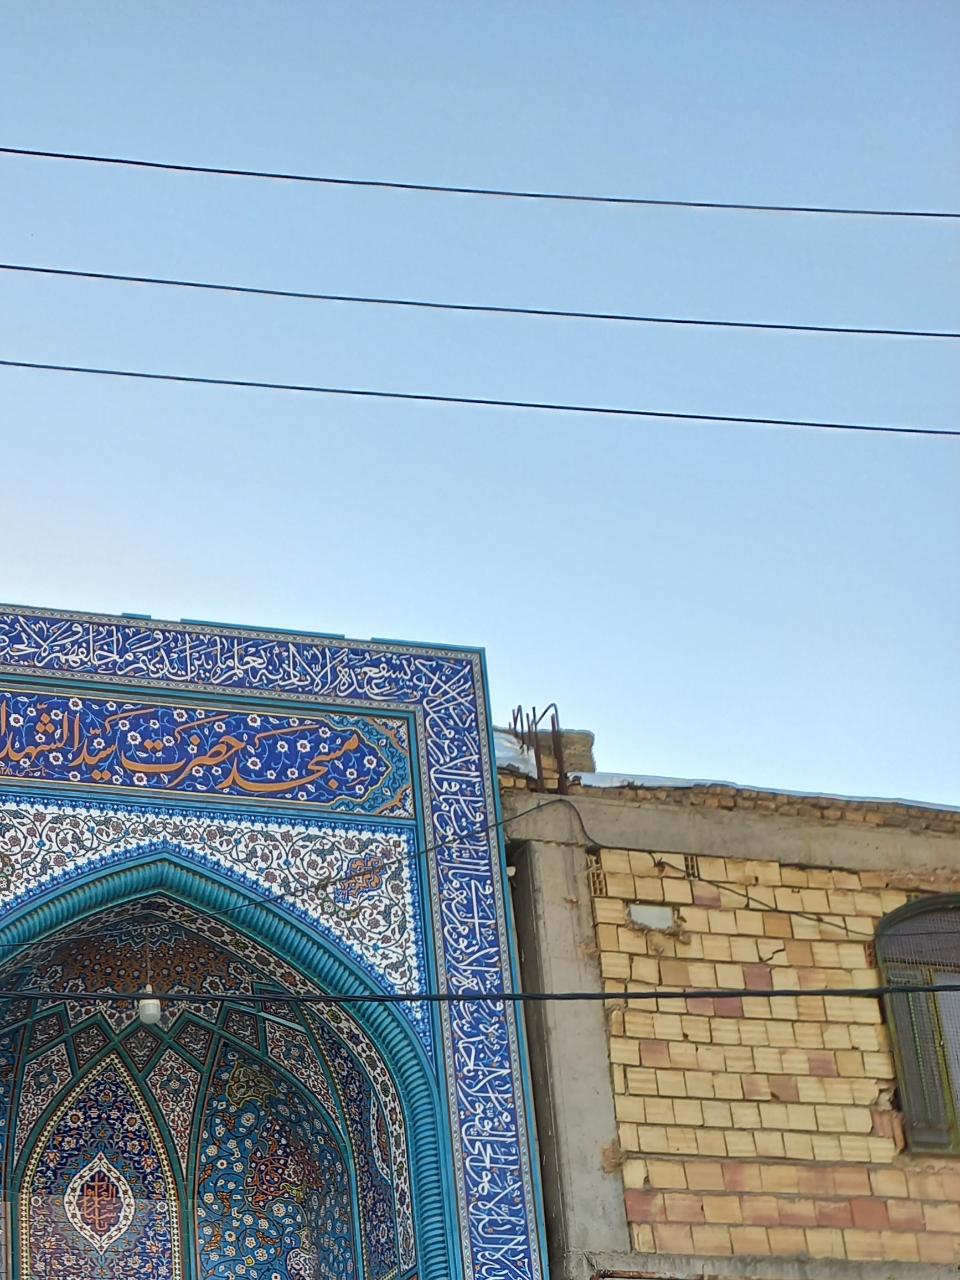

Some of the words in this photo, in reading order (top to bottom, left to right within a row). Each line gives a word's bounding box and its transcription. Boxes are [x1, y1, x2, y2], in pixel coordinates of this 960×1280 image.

[68, 728, 117, 782] سید
[121, 735, 246, 789] حضرت
[215, 733, 360, 792] مسجد
